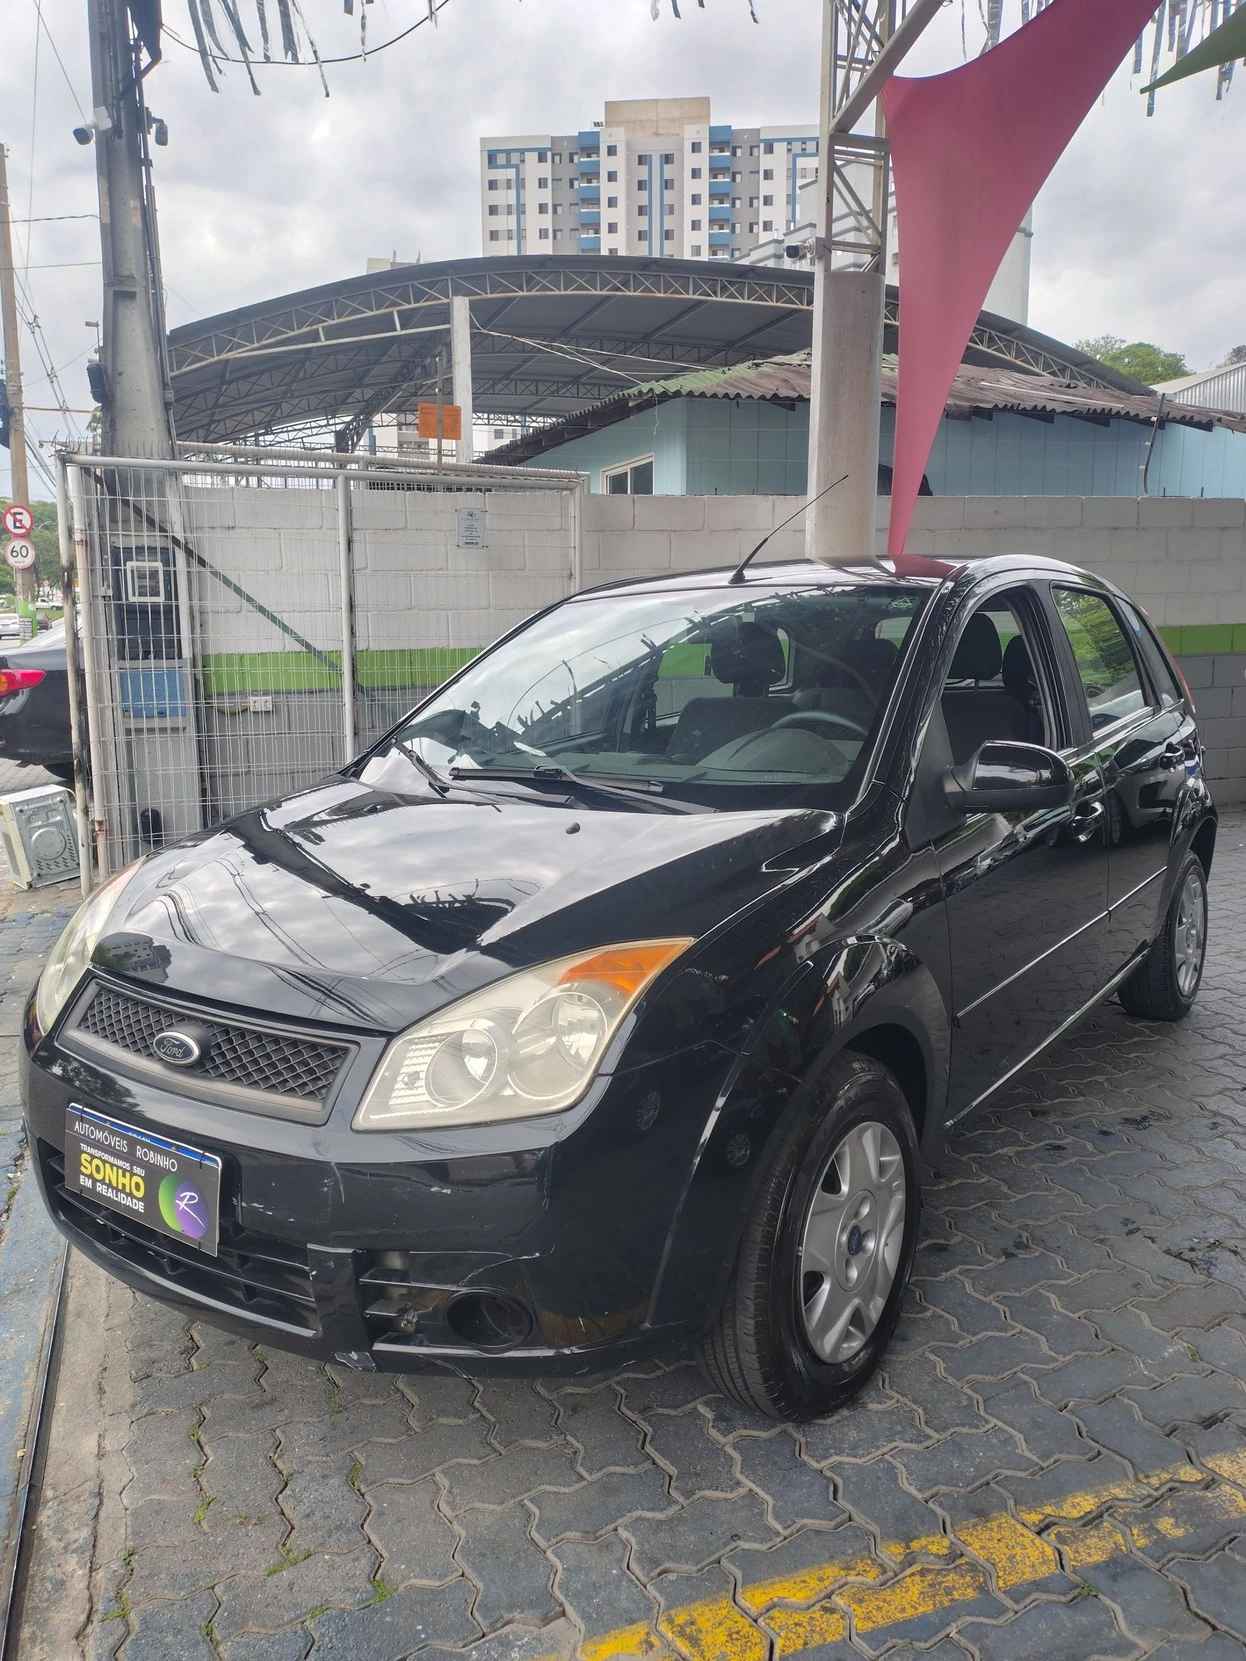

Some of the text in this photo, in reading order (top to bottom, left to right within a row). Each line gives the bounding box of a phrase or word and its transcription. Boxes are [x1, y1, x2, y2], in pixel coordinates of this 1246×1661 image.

[13, 512, 25, 529] E
[11, 545, 29, 558] 60
[160, 1037, 186, 1058] Ford
[73, 1120, 178, 1172] AUTOMÓVEIS ROBINHO
[80, 1143, 145, 1177] TRANSFORMAMOS SEU
[80, 1153, 145, 1198] SONHO
[80, 1174, 145, 1213] EM REALIDADE
[175, 1191, 206, 1229] R
